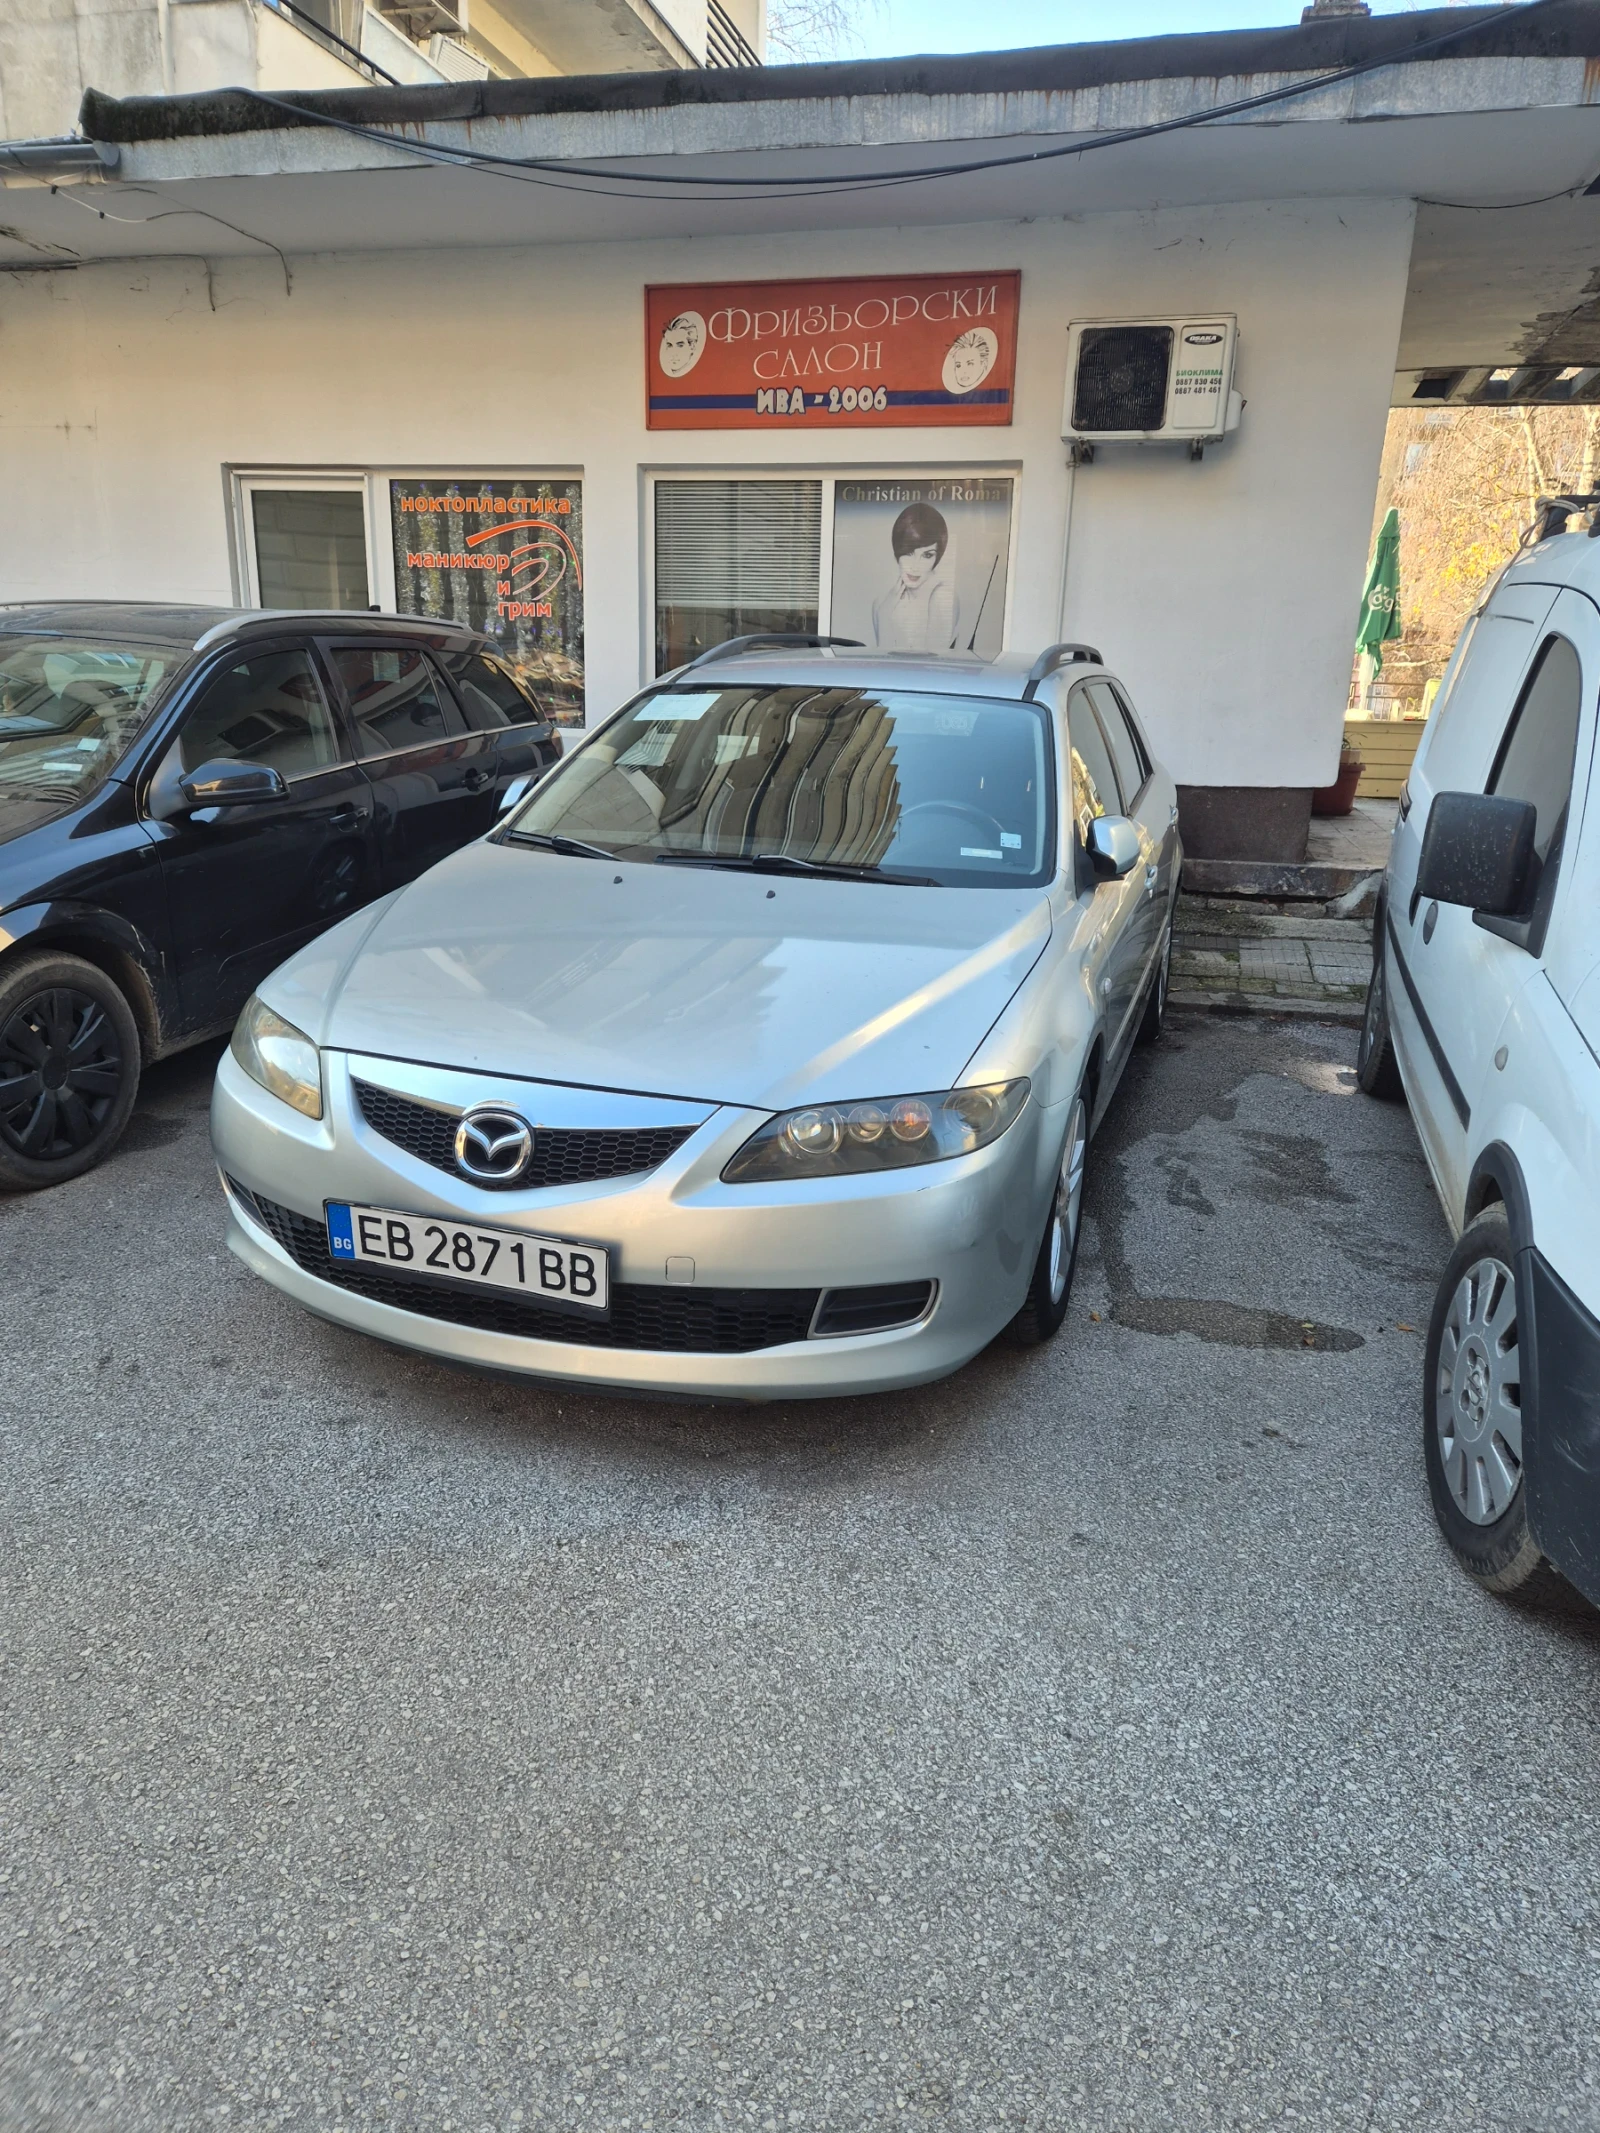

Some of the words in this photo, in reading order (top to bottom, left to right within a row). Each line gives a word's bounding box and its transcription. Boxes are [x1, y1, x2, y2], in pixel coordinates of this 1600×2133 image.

[708, 285, 998, 343] ФРИЗЬОРСКИ
[753, 341, 883, 379] САЛОН
[1176, 369, 1223, 377] БИОКЛИМА
[1176, 378, 1192, 386] 0887
[756, 387, 805, 415] ИВА
[829, 385, 888, 413] 2006
[842, 486, 922, 501] Christian
[927, 486, 947, 501] of
[951, 485, 1003, 501] Roma
[401, 496, 571, 513] ноктопластика
[407, 552, 510, 573] маникюр
[497, 580, 511, 596] и
[498, 601, 552, 621] грим
[333, 1236, 352, 1250] BG
[424, 1225, 526, 1283] 2871
